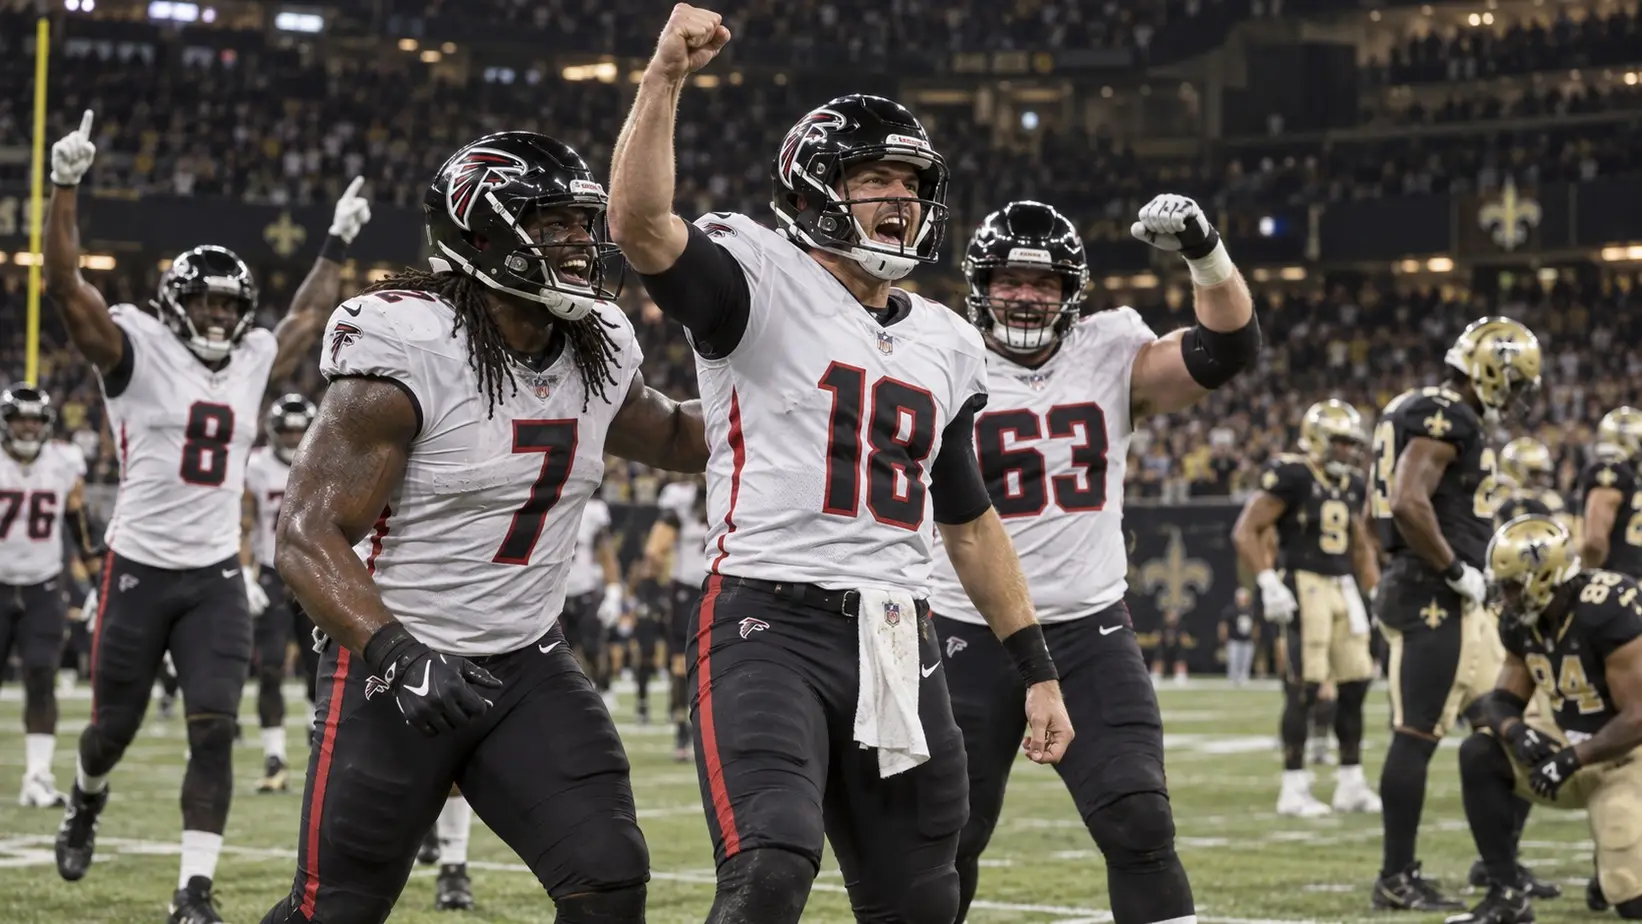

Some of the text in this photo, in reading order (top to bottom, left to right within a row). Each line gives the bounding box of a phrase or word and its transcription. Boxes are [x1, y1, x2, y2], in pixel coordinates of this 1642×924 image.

[180, 400, 235, 487] 8
[491, 418, 579, 565] 7
[817, 360, 937, 532] 18
[975, 401, 1108, 519] 63
[0, 489, 56, 541] 76
[1319, 499, 1349, 555] 9
